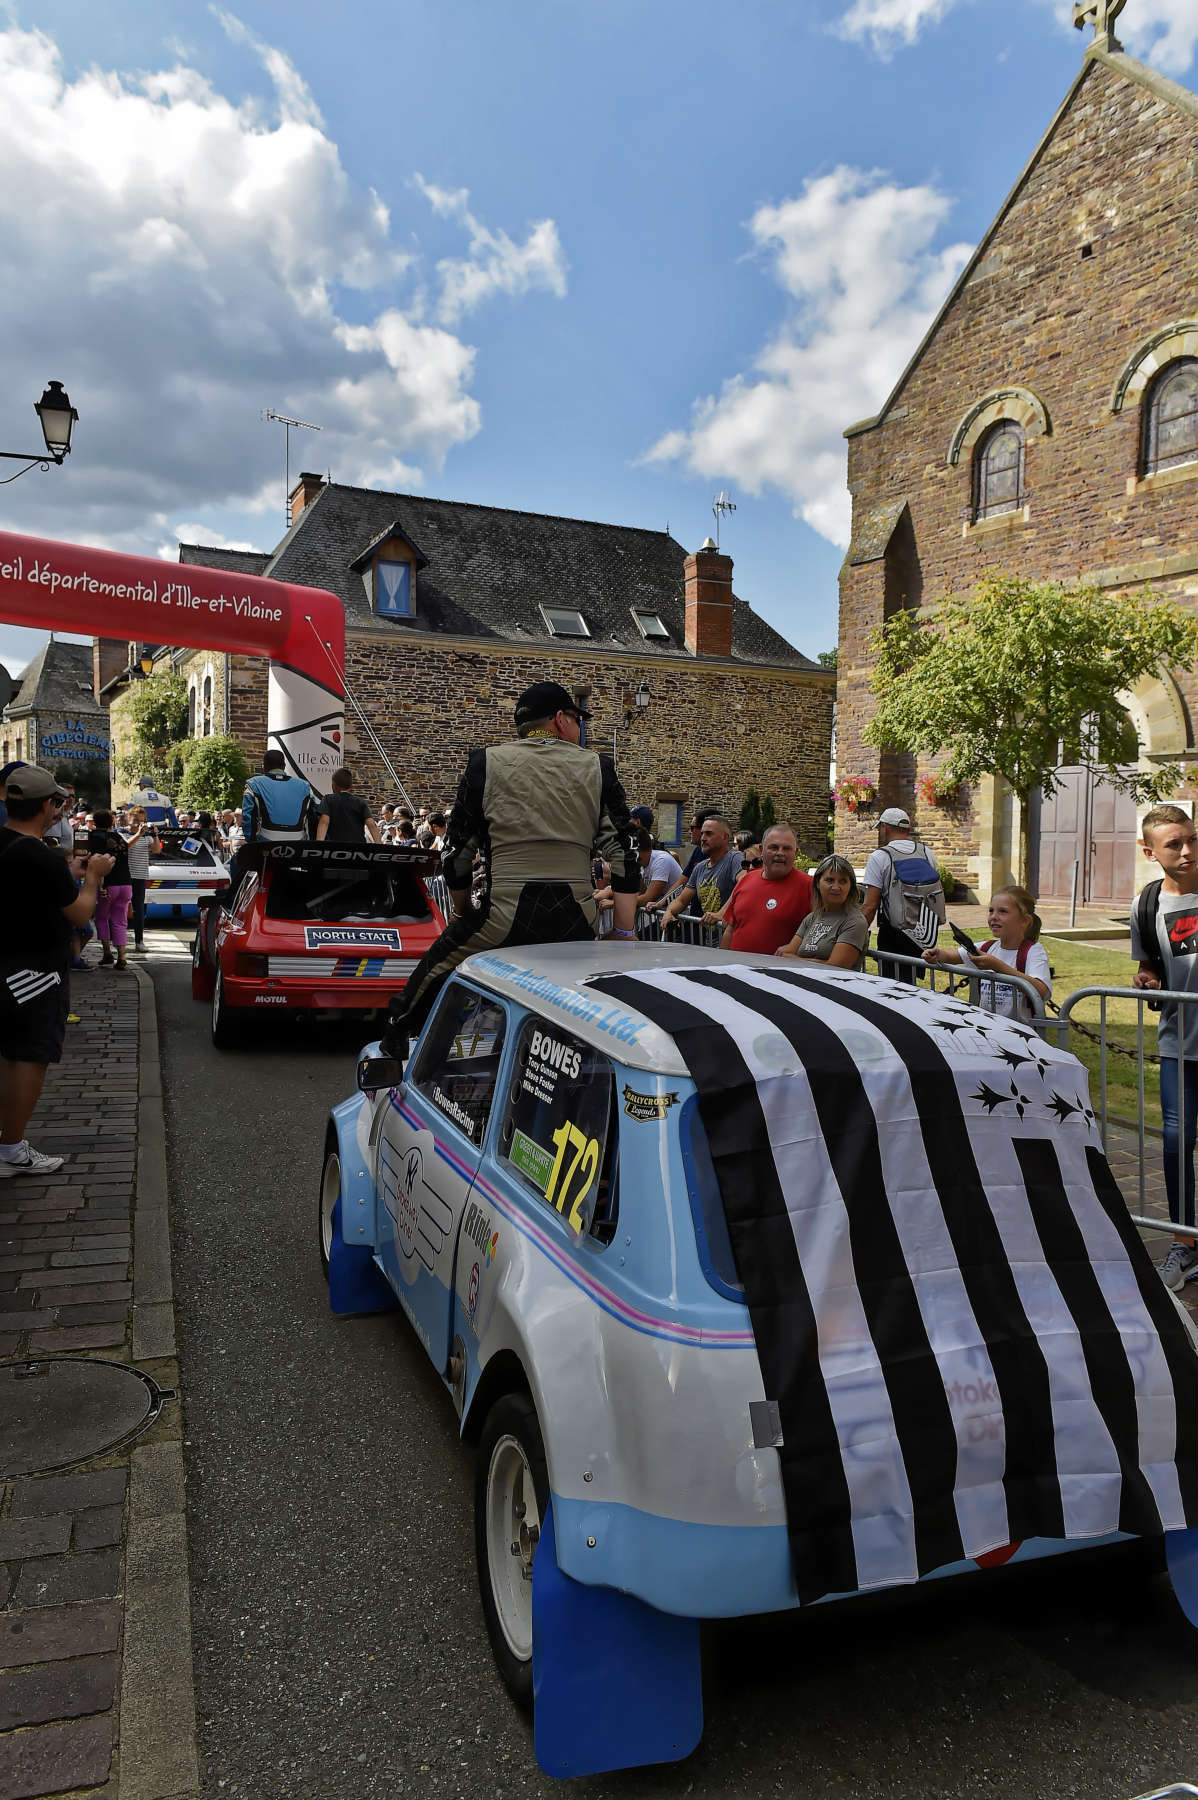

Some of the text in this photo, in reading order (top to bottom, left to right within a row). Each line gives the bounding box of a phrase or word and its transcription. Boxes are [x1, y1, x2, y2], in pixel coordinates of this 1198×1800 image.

[0, 556, 283, 621] eil départemental d'Ille-et-Vilaine
[67, 719, 85, 731] LA
[331, 755, 344, 767] Vil
[301, 849, 429, 864] PIONEER
[312, 931, 395, 942] NORTH STATE
[255, 995, 288, 1003] MOTUL
[510, 968, 602, 1023] Automation
[596, 1007, 648, 1047] Ltd.
[530, 1030, 582, 1079] BOWES
[522, 1079, 534, 1094] Mike
[525, 1068, 555, 1092] Steve Foster
[626, 1091, 670, 1106] RALLYCROSS
[631, 1104, 656, 1117] Legends
[544, 1119, 599, 1236] 172
